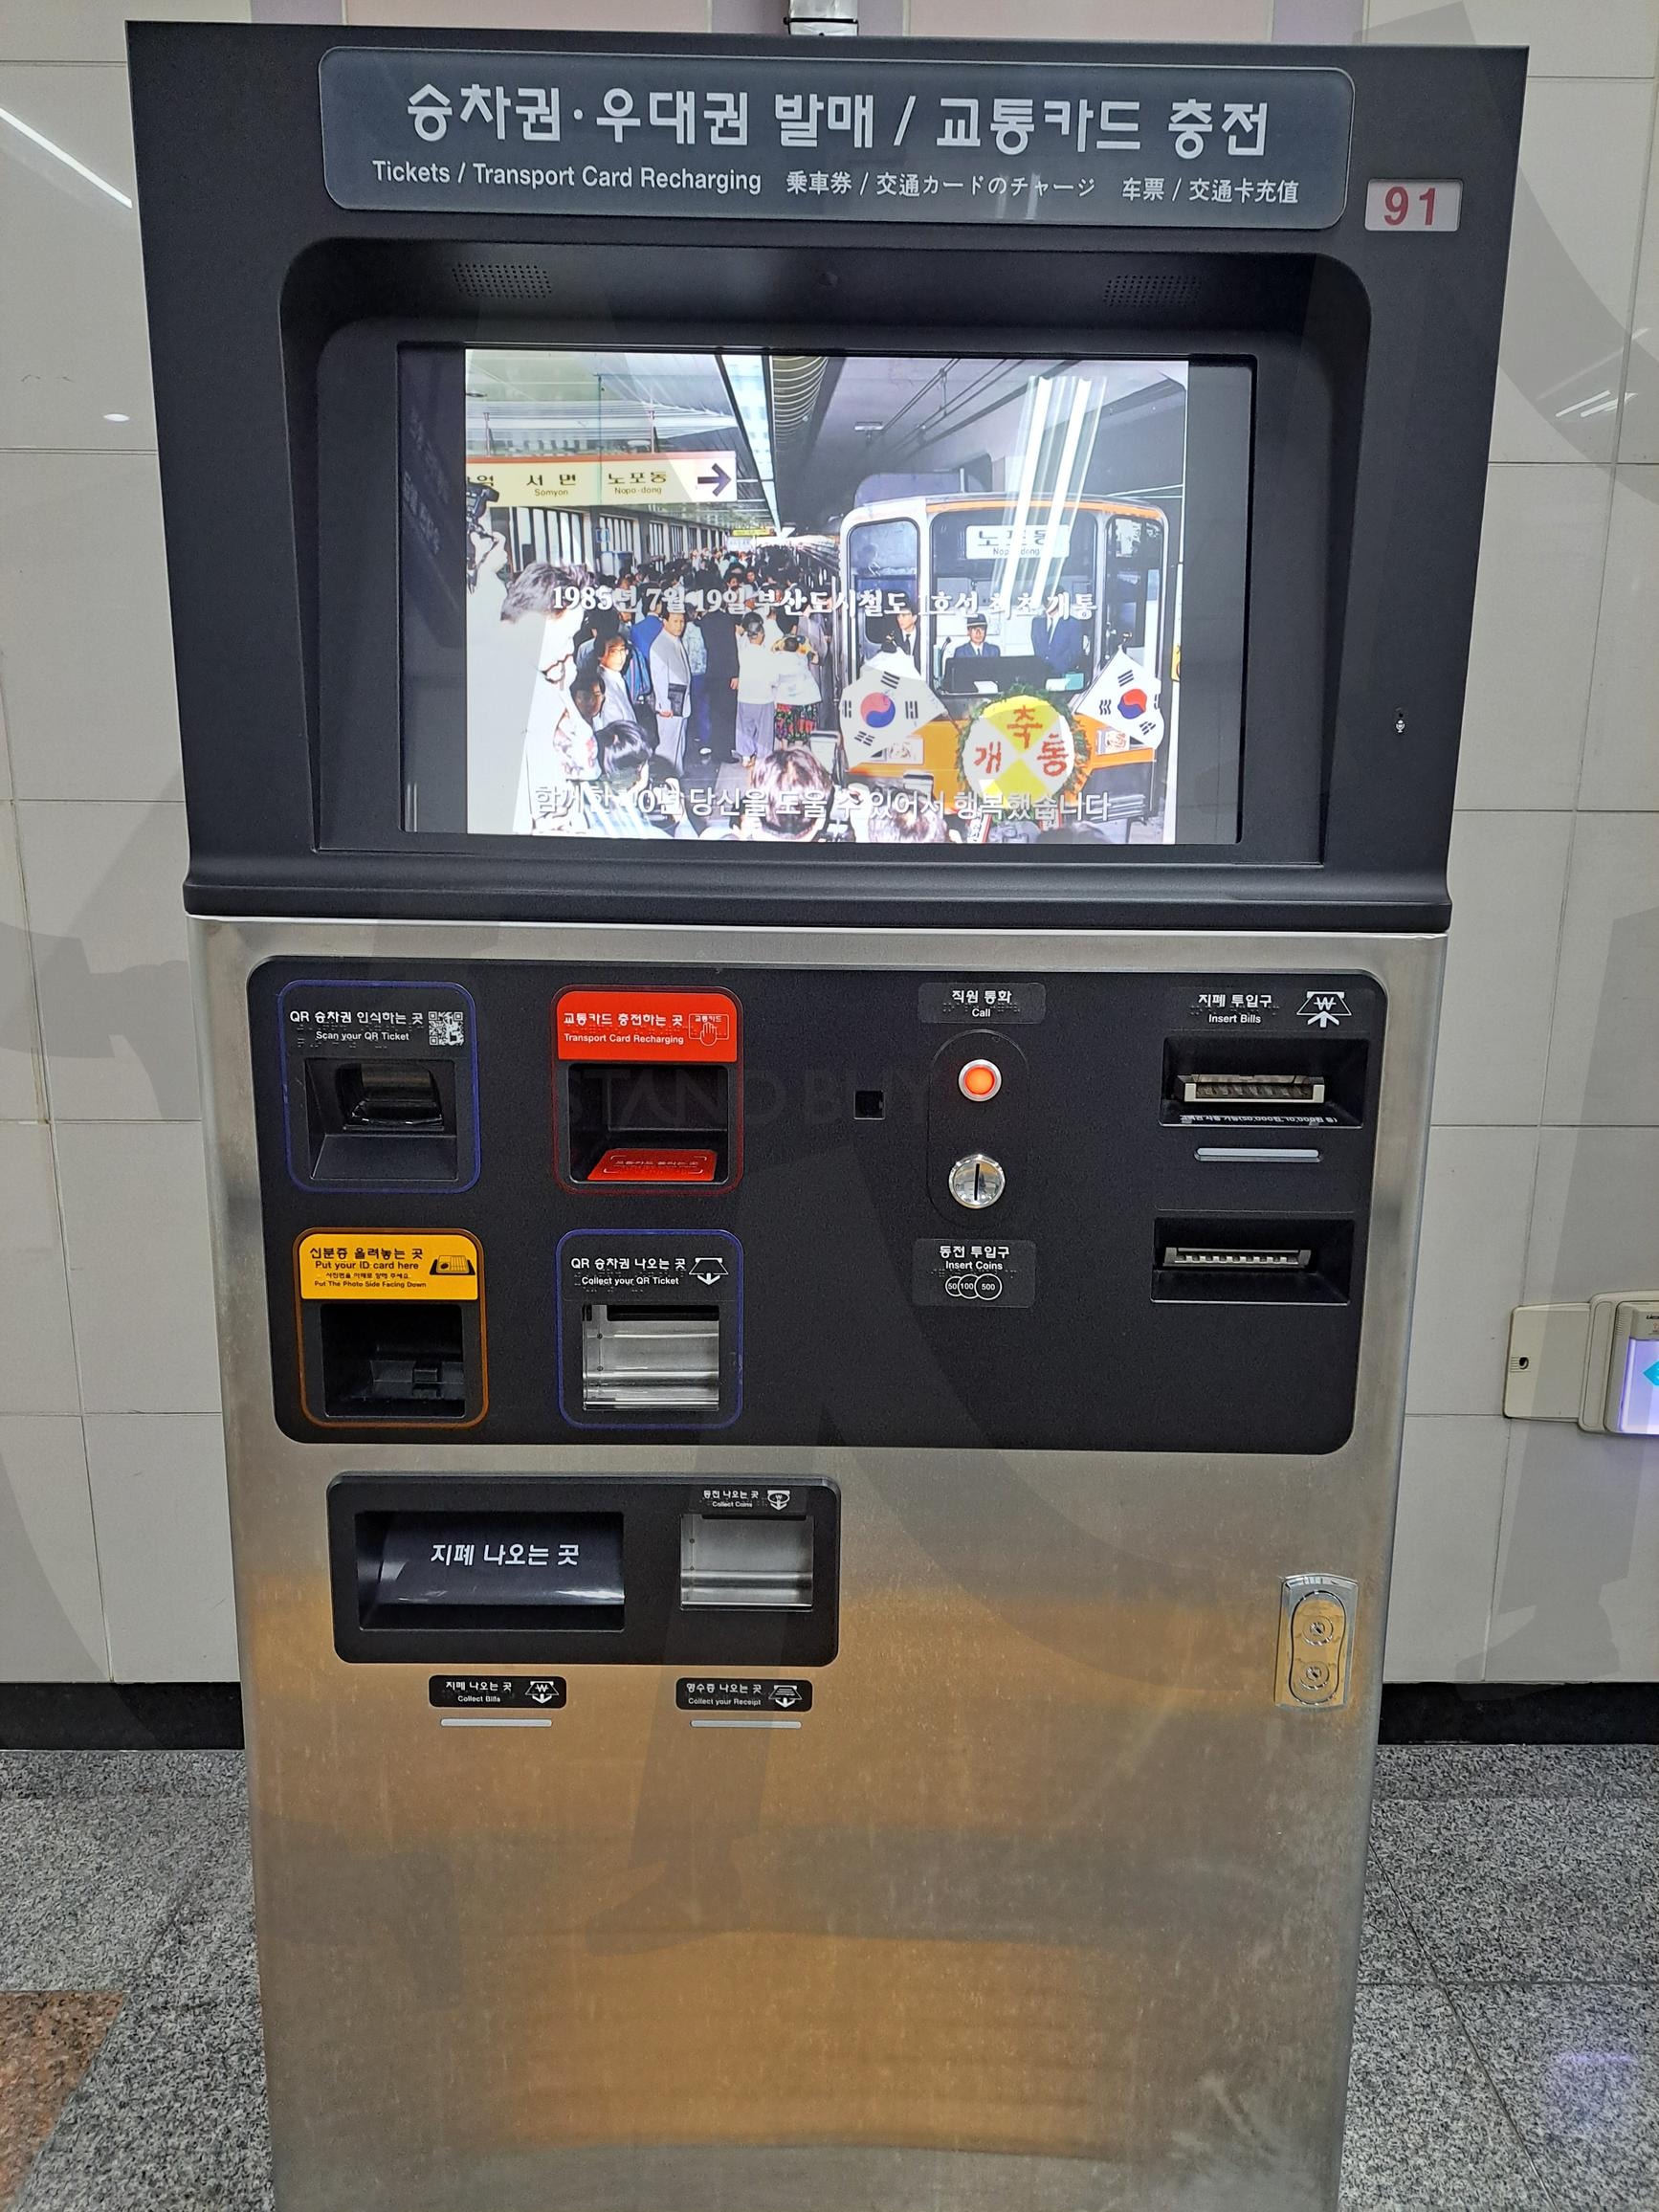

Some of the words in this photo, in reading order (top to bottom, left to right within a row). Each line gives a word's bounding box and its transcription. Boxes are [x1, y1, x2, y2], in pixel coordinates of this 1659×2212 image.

[408, 83, 748, 146] 승차권·우대권
[774, 93, 874, 150] 발매
[894, 95, 916, 147] /
[937, 98, 1141, 157] 교통카드
[1167, 100, 1269, 161] 충전
[373, 159, 450, 185] Tickets
[457, 161, 466, 184] /
[474, 164, 574, 189] Transport
[582, 165, 632, 188] Card
[640, 166, 762, 195] Recharging
[785, 170, 852, 195] 乗車券
[859, 172, 870, 197] /
[876, 172, 1095, 198] 交通カードのチャージ
[1122, 177, 1164, 203] 车票
[1173, 179, 1182, 203] /
[1189, 177, 1299, 205] 交通卡充值
[1382, 186, 1437, 228] 91
[608, 471, 666, 484] 노포동
[552, 585, 636, 613] 1985년
[646, 587, 686, 614] 7월
[696, 585, 746, 615] 19일
[755, 587, 908, 619] 부산도시철도
[918, 589, 979, 618] 1호선
[1047, 590, 1097, 621] 개통
[1006, 704, 1043, 749] 축
[690, 786, 767, 818] 당신을
[776, 789, 828, 819] 도울
[869, 790, 945, 820] 있어서
[953, 790, 1112, 822] 행복했습니다
[951, 989, 979, 1004] 직원
[984, 989, 1012, 1005] 통화
[1198, 994, 1226, 1007] 지폐
[1230, 994, 1272, 1008] 투입구
[290, 1010, 310, 1023] QR
[315, 1010, 352, 1024] 승차권
[357, 1011, 407, 1025] 인식하는
[411, 1012, 424, 1025] 곳
[564, 1013, 612, 1026] 교통카드
[617, 1012, 667, 1027] 충전하는
[672, 1014, 683, 1027] 곳
[971, 1008, 991, 1017] Call
[1208, 1014, 1237, 1024] Insert
[1240, 1014, 1262, 1024] Bills
[316, 1030, 339, 1040] Scan
[341, 1032, 362, 1041] your
[365, 1031, 379, 1040] QR
[382, 1031, 409, 1041] Ticket
[564, 1032, 607, 1044] Transport
[609, 1033, 631, 1043] Card
[633, 1034, 684, 1045] Recharging
[310, 1247, 348, 1260] 신분증
[354, 1247, 406, 1260] 올려놓는
[411, 1248, 424, 1260] 곳
[940, 1245, 965, 1259] 동전
[970, 1246, 1010, 1259] 투입구
[315, 1260, 332, 1270] Put
[335, 1262, 356, 1272] your
[359, 1261, 370, 1270] ID
[373, 1261, 394, 1270] card
[397, 1261, 419, 1270] here
[570, 1257, 590, 1269] QR
[594, 1257, 630, 1271] 승차권
[634, 1258, 670, 1270] 나오는
[675, 1258, 687, 1270] 곳
[945, 1260, 973, 1270] Insert
[975, 1260, 1003, 1271] Coins
[582, 1276, 612, 1285] Collect
[636, 1276, 651, 1285] QR
[653, 1276, 679, 1285] Ticket
[703, 1490, 719, 1499] 동전
[722, 1490, 748, 1499] 나오는
[750, 1491, 760, 1499] 곳
[431, 1543, 476, 1566] 지폐
[483, 1543, 549, 1566] 나오는
[558, 1544, 580, 1566] 곳
[446, 1681, 466, 1691] 지폐
[469, 1681, 498, 1692] 나오는
[502, 1681, 512, 1692] 곳
[686, 1683, 716, 1693] 영수증
[719, 1683, 748, 1693] 나오는
[752, 1684, 762, 1694] 곳
